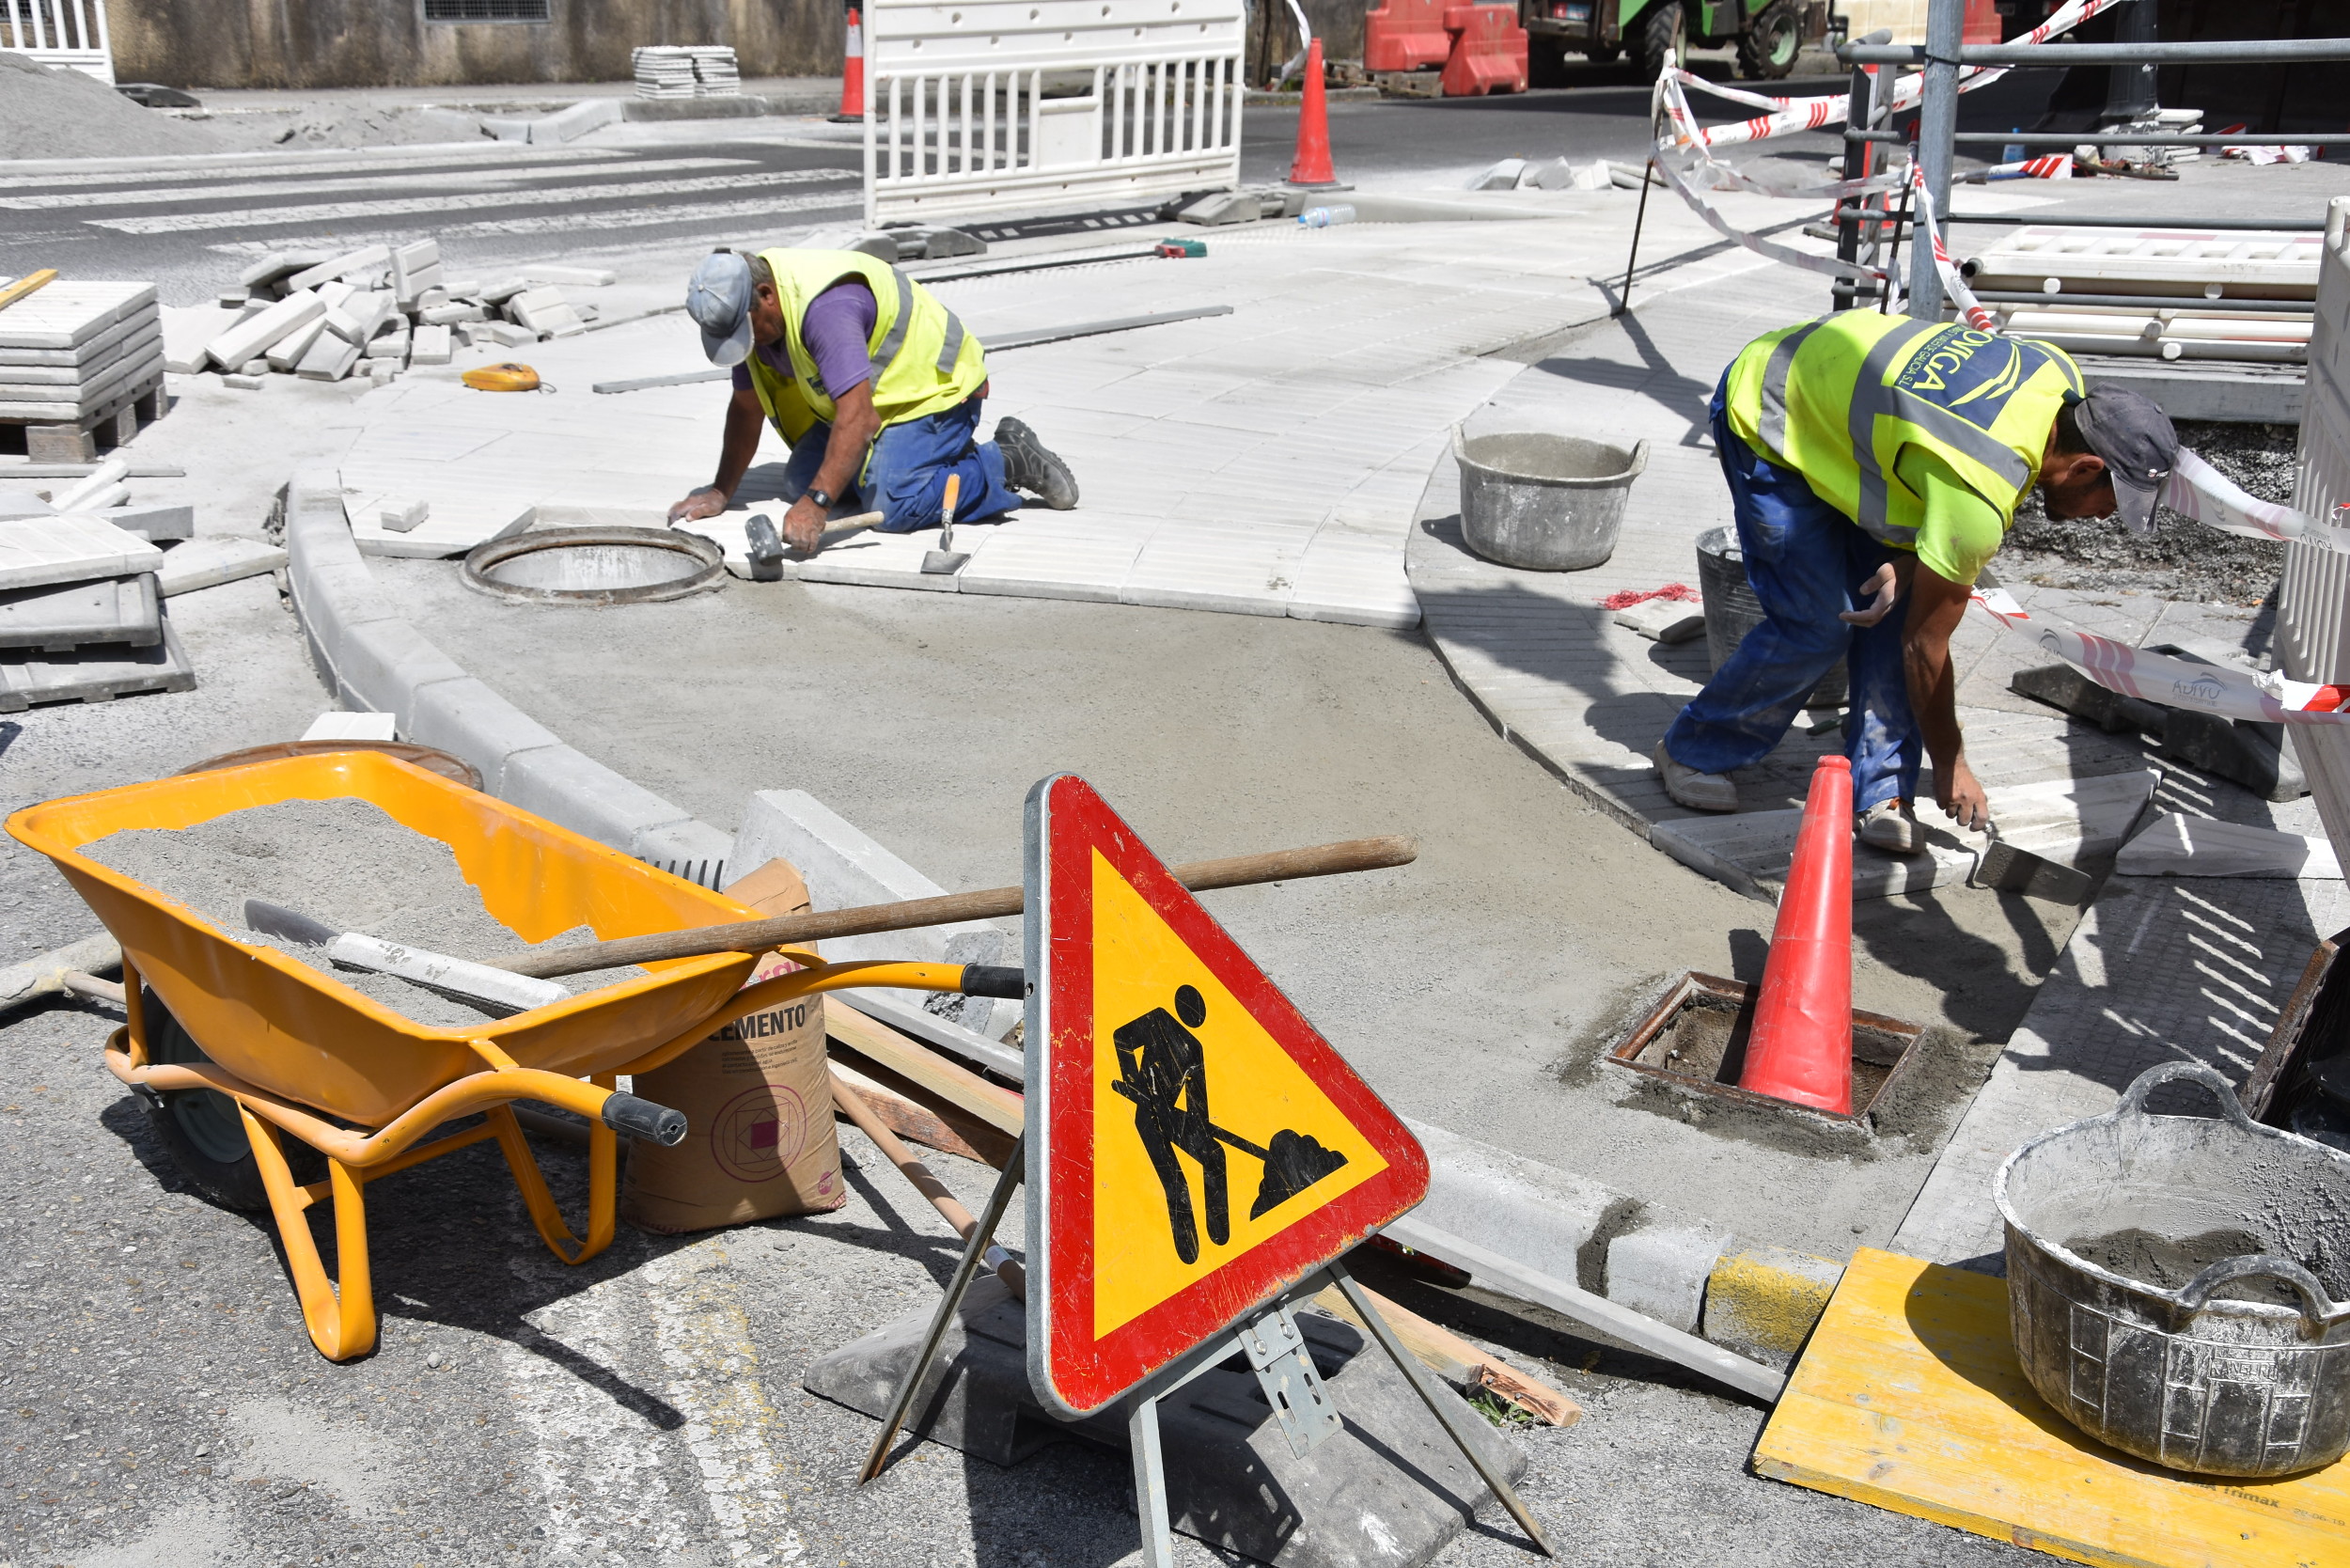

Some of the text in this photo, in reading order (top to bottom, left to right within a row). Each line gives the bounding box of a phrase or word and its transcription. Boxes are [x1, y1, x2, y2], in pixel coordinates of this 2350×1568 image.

[1906, 351, 1931, 375] GALICIA
[1912, 330, 1993, 389] OVIGA
[2224, 1485, 2280, 1508] Trimax
